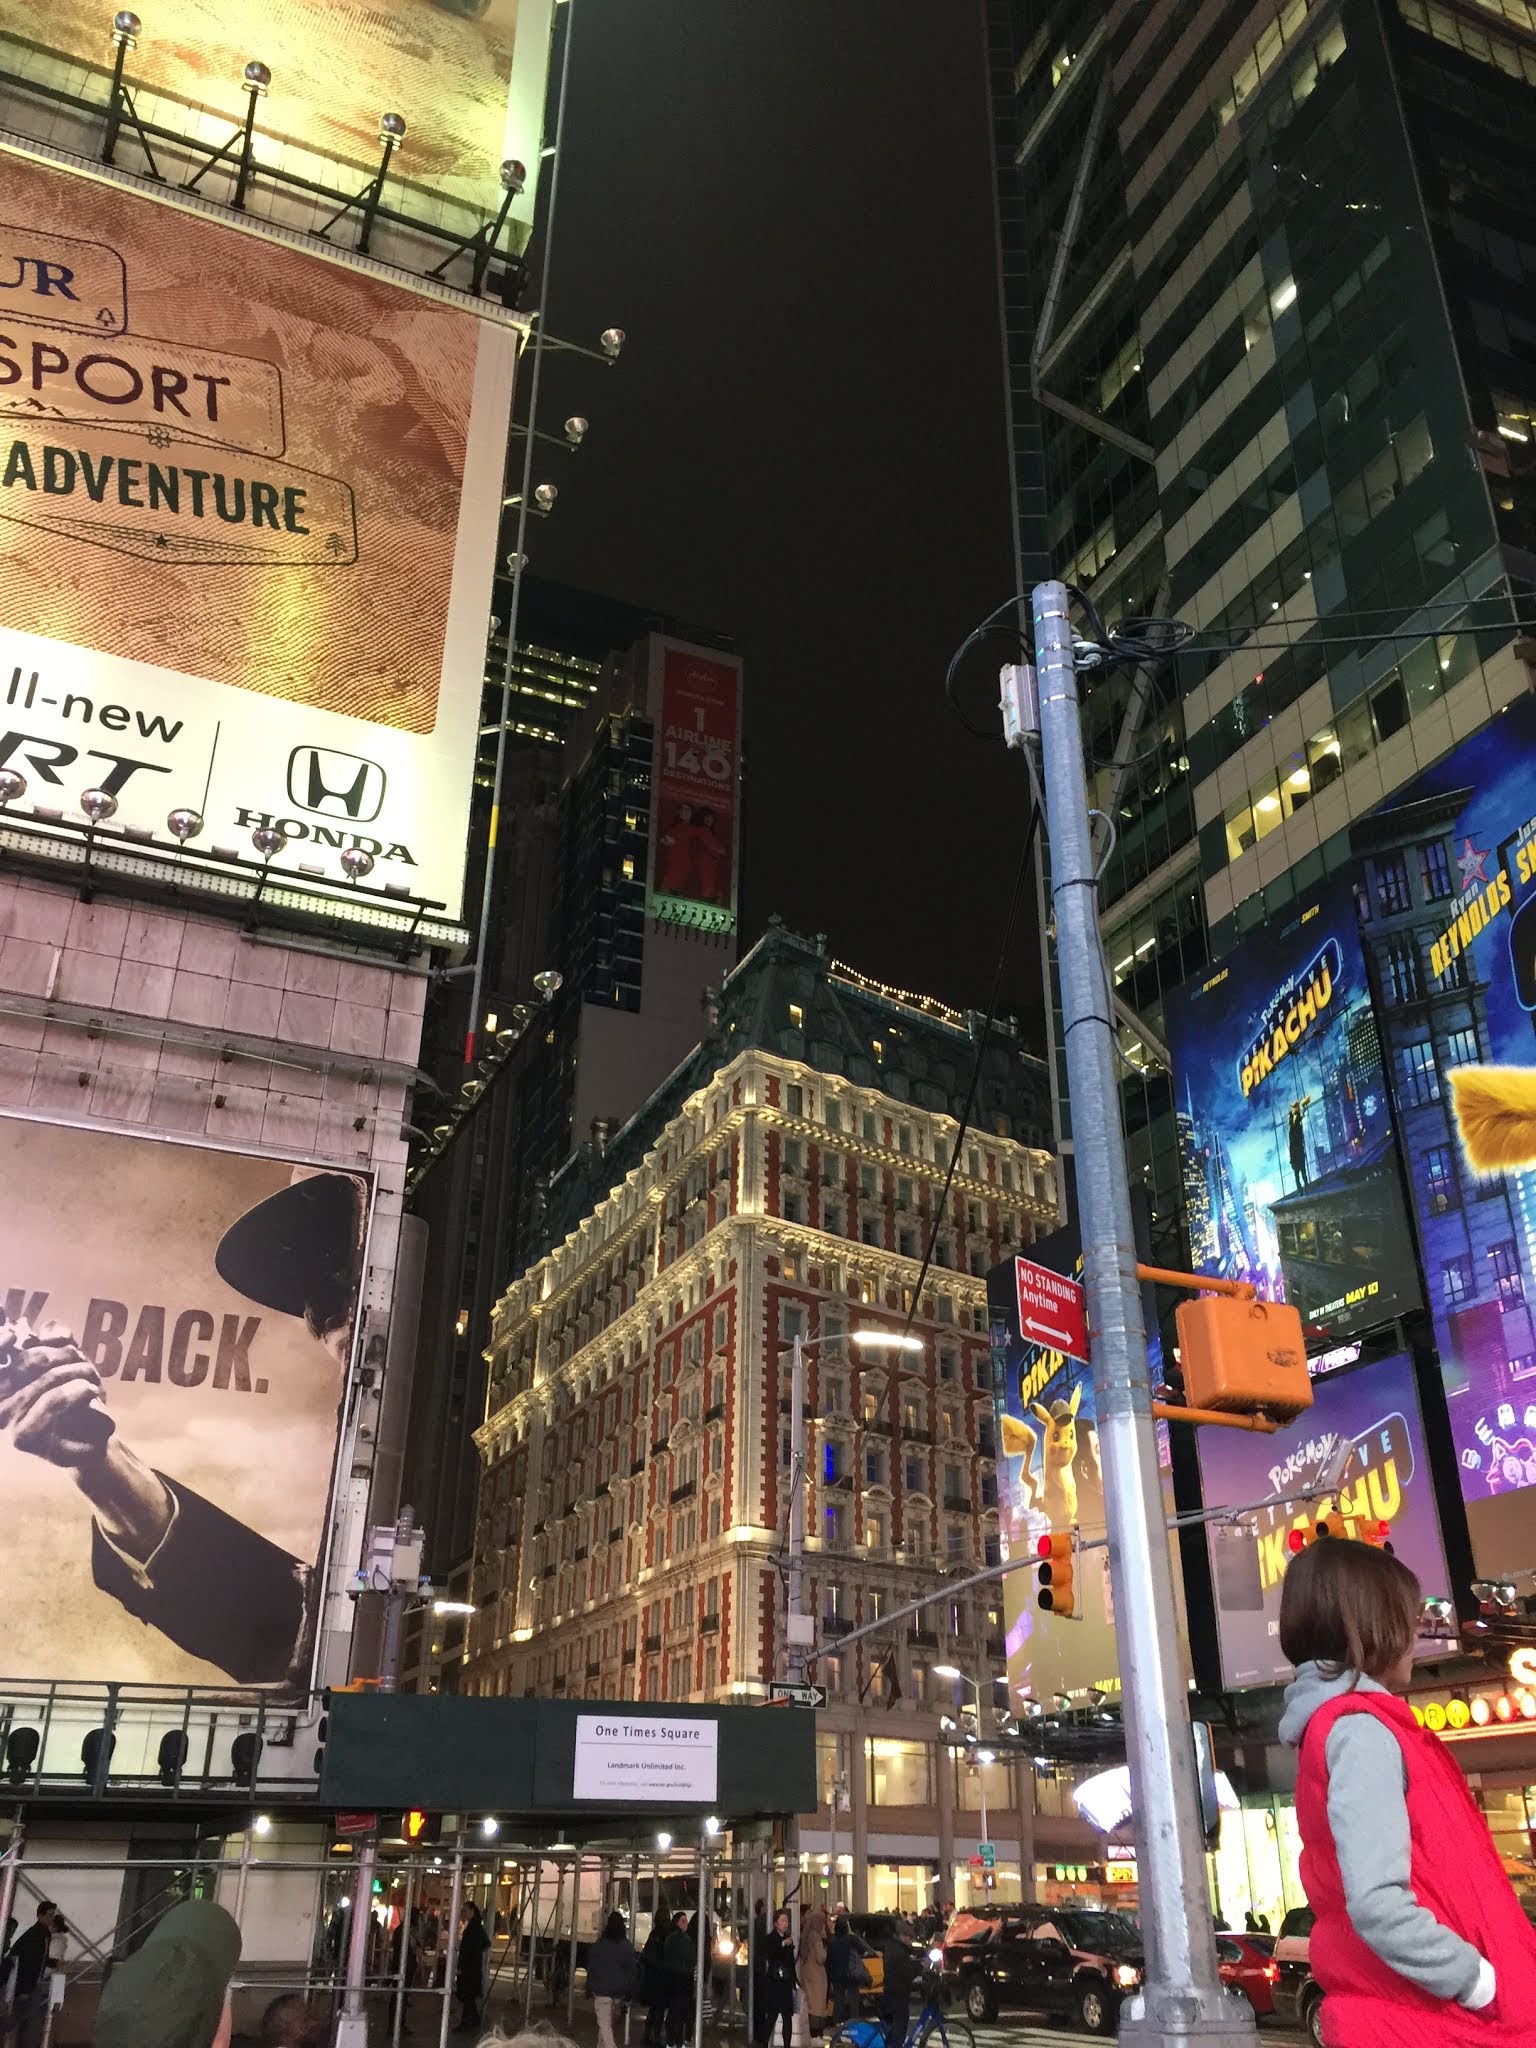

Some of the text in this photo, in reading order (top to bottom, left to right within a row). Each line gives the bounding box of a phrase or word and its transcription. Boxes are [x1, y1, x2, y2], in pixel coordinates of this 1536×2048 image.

[3, 440, 311, 535] ADVENTURE
[694, 707, 705, 732] 1
[665, 724, 732, 753] AIRLINE
[233, 807, 419, 866] HONDA
[1450, 882, 1478, 919] Ryan
[1430, 869, 1511, 979] REYNOLDS
[1020, 1267, 1077, 1304] NO STANDING
[1345, 1286, 1366, 1304] MAY
[1367, 1281, 1379, 1296] 10
[1023, 1286, 1059, 1313] Anytime
[82, 1297, 270, 1395] BACK.
[801, 1691, 819, 1701] WAY
[1094, 1679, 1113, 1693] MAY
[595, 1725, 700, 1741] One Times Square
[607, 1761, 639, 1769] Landmark
[641, 1762, 673, 1770] Unlimited
[1112, 1867, 1133, 1882] OPEN
